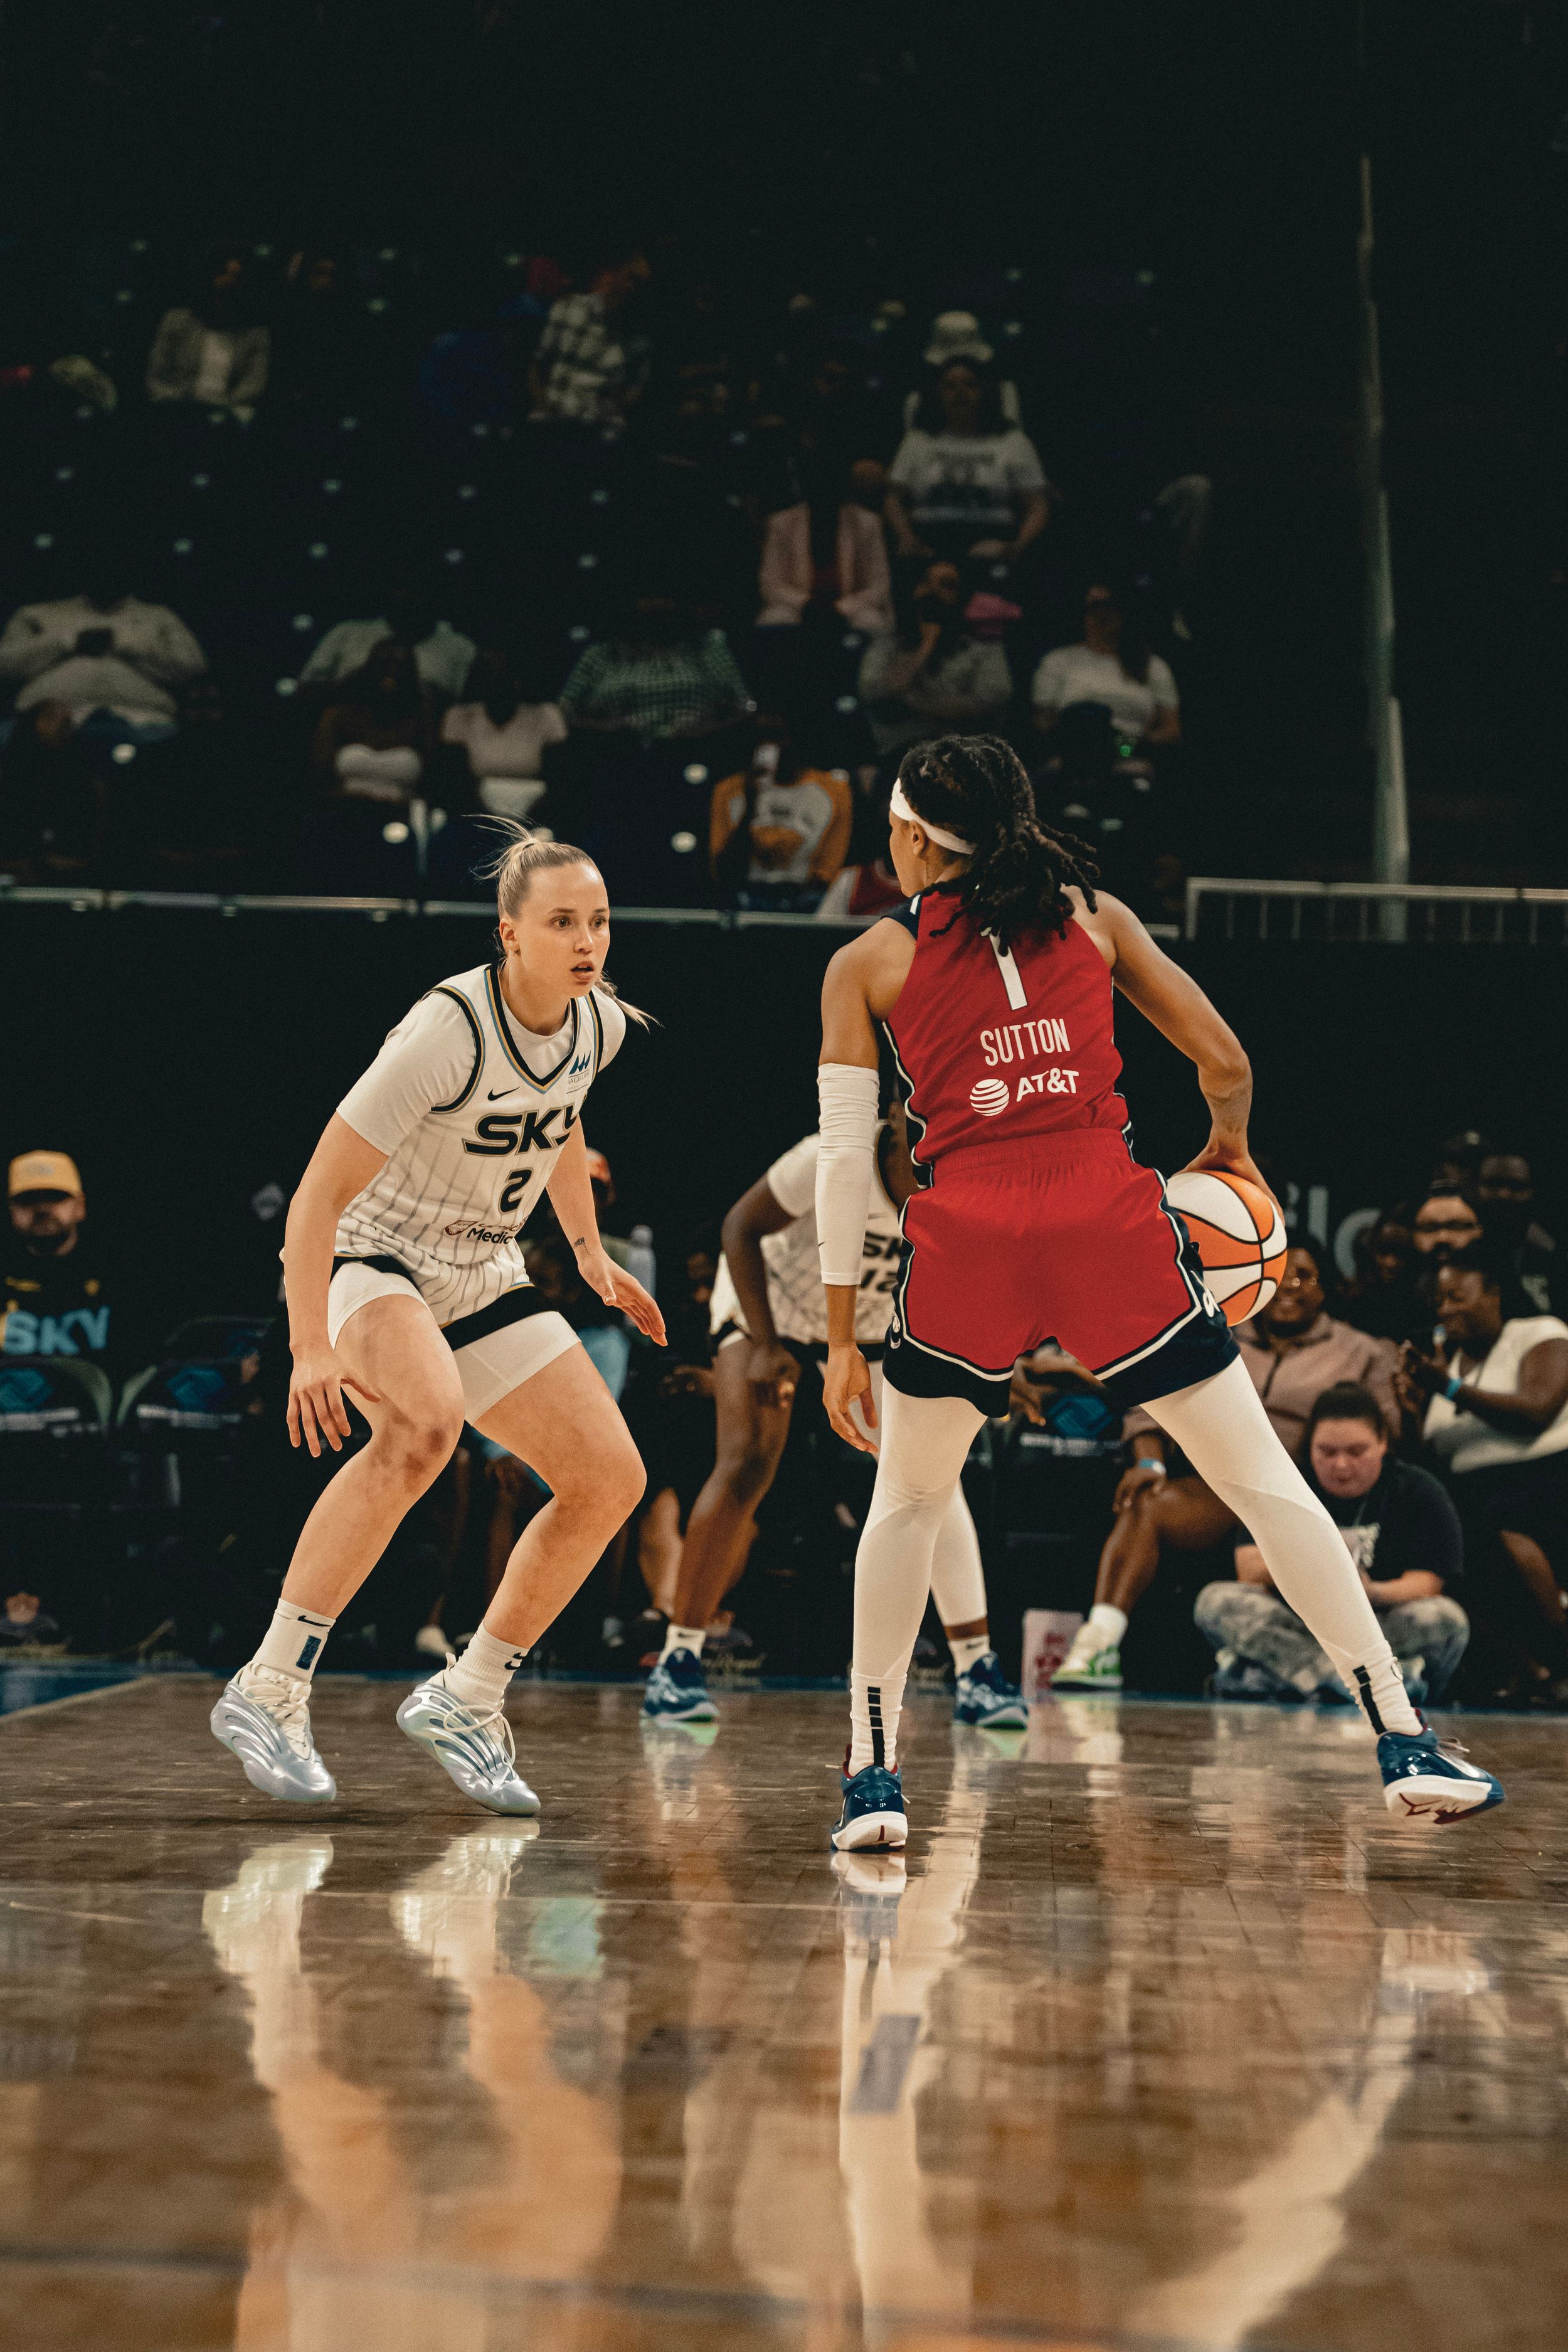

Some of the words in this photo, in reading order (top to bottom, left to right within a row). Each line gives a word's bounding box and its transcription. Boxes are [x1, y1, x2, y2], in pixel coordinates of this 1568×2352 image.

[979, 926, 1029, 1010] 1
[980, 1017, 1071, 1067] SUTTON
[1015, 1067, 1080, 1103] AT&T
[498, 1167, 534, 1214] 2
[4, 1304, 112, 1356] SKY
